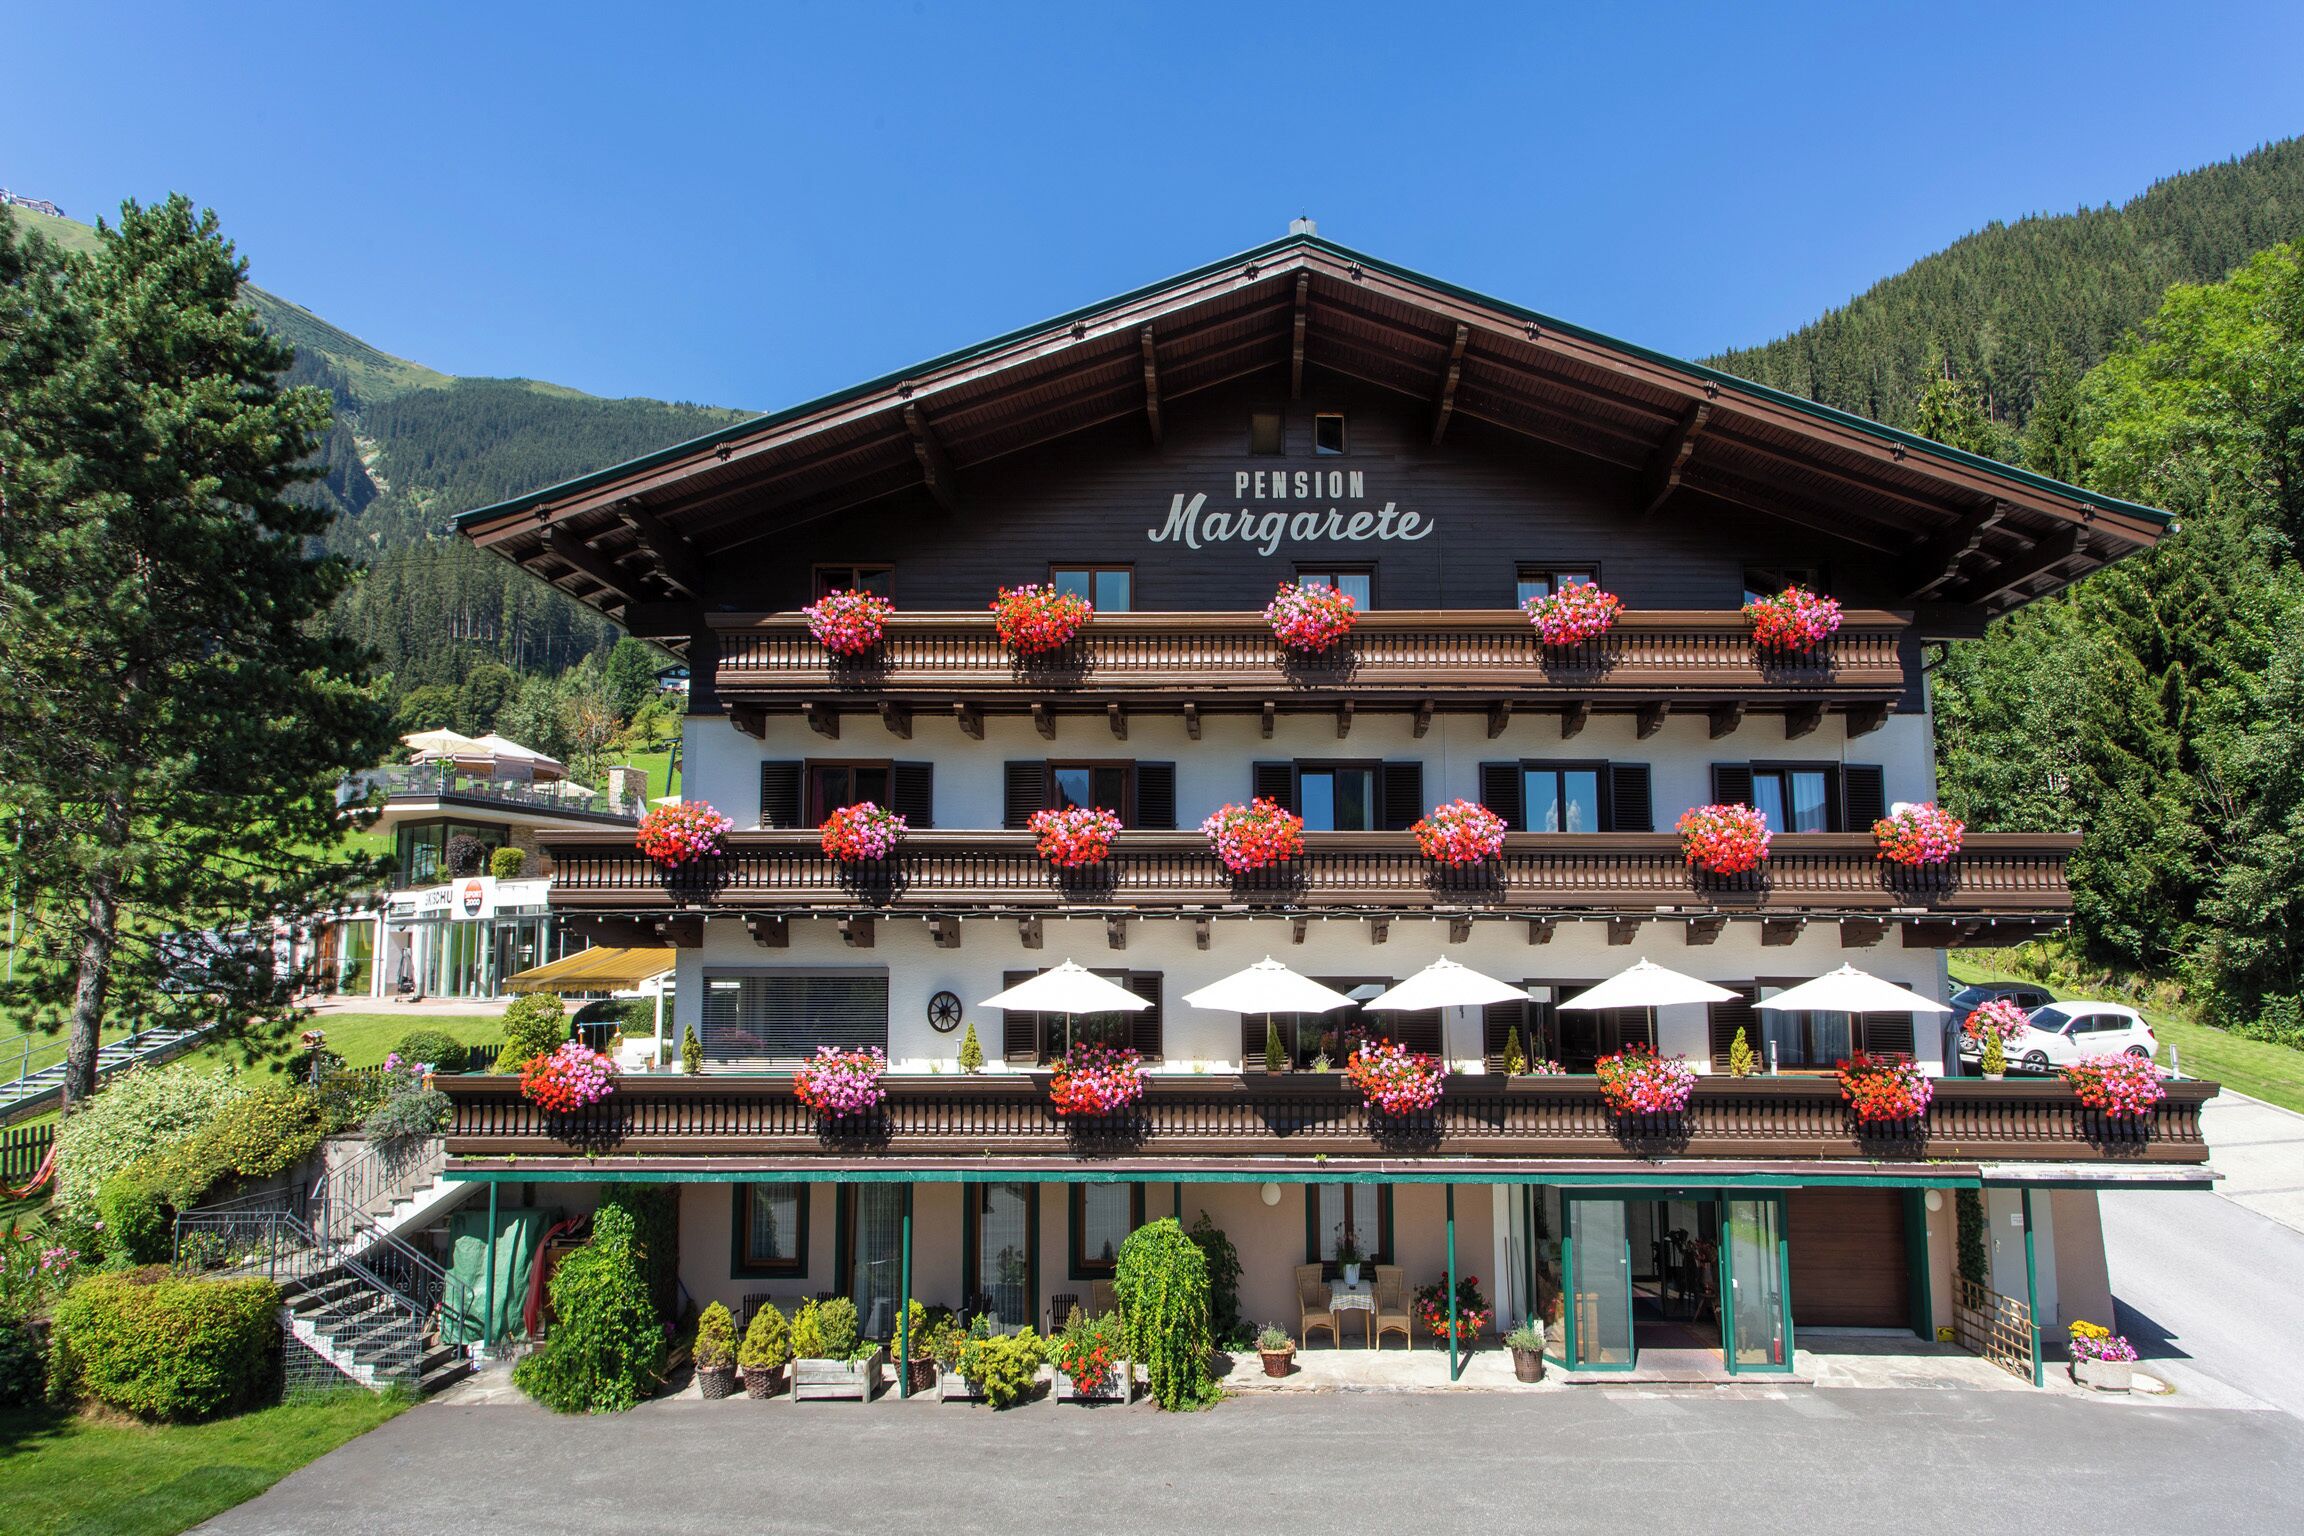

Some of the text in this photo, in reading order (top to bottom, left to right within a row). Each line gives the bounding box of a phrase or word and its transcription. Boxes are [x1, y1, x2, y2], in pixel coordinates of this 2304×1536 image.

[1236, 471, 1364, 499] PENSION
[1147, 492, 1434, 557] Margarete
[464, 890, 482, 899] SPORT
[465, 898, 481, 906] 2000
